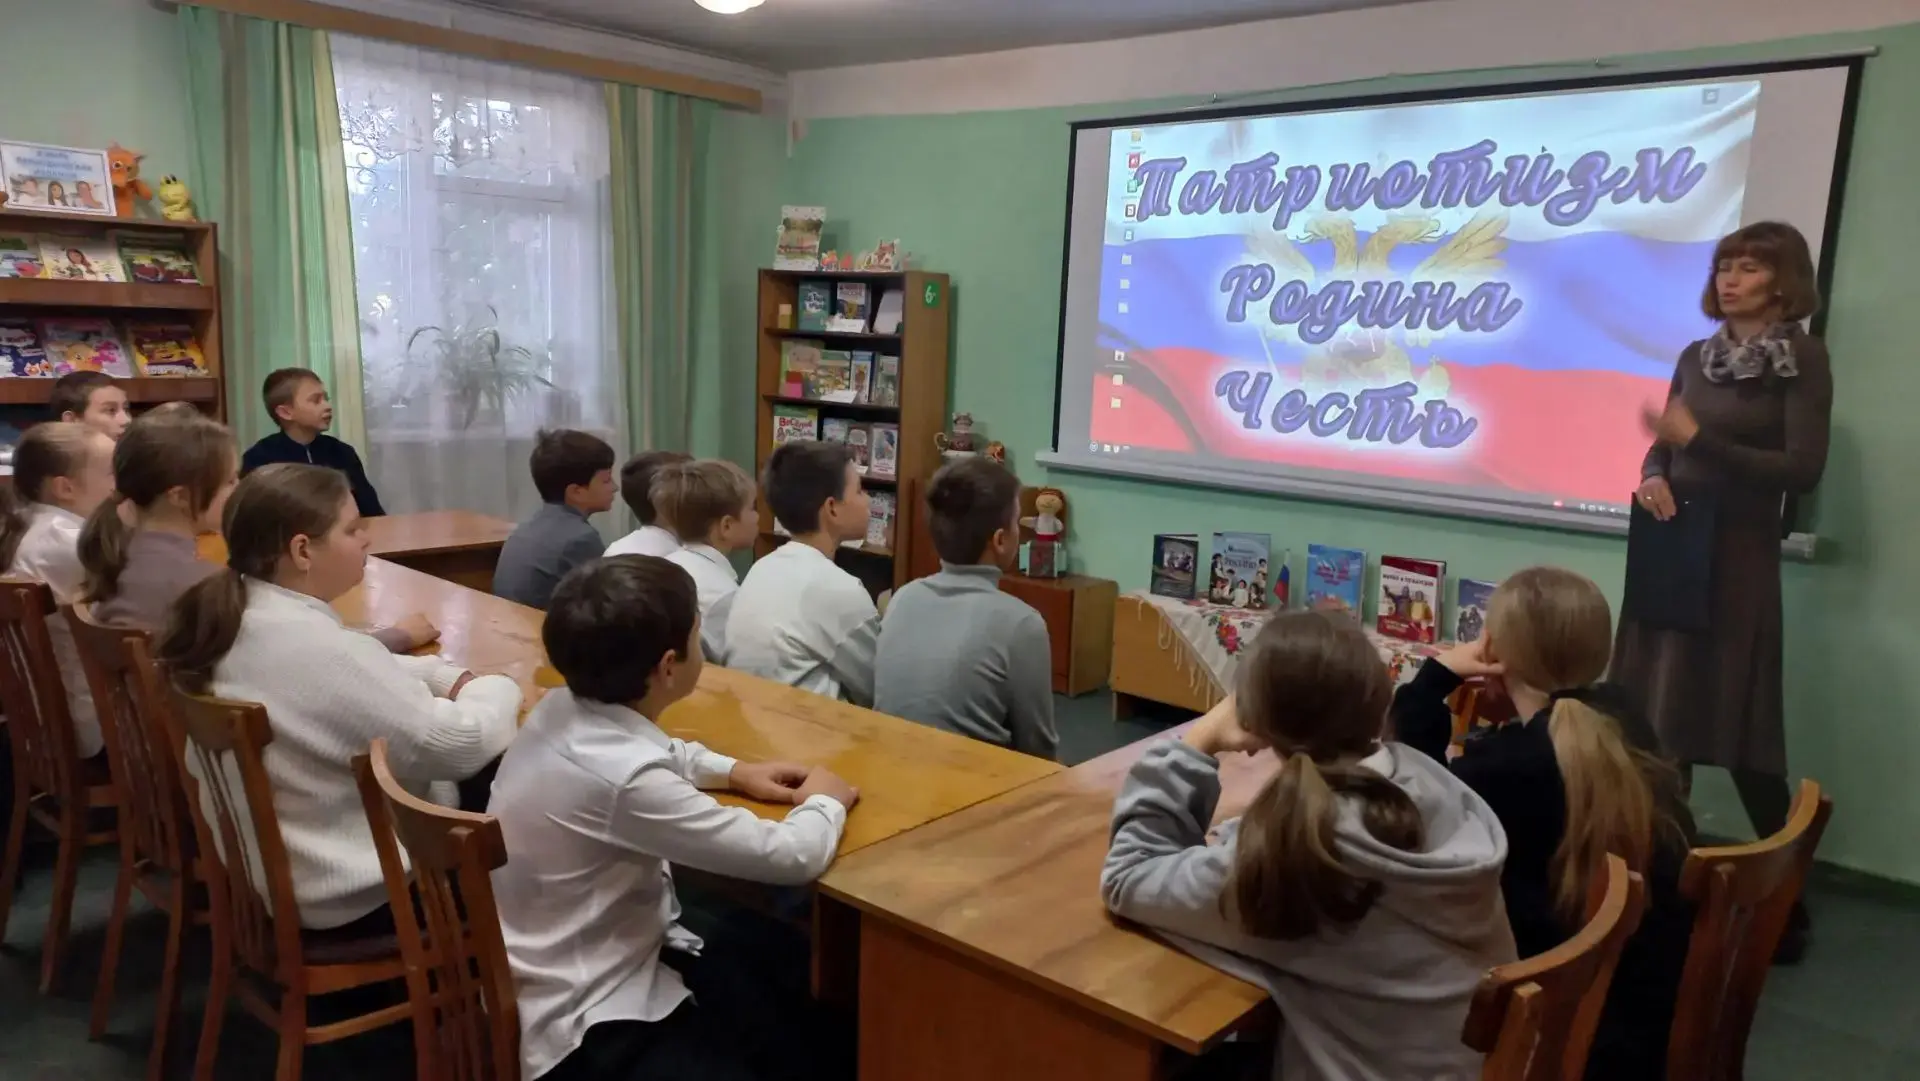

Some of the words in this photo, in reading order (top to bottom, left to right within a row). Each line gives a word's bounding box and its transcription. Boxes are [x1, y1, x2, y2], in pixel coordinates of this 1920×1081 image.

[1134, 138, 1707, 231] Патриотизм
[1220, 263, 1523, 345] Родина
[1214, 370, 1478, 448] Честь
